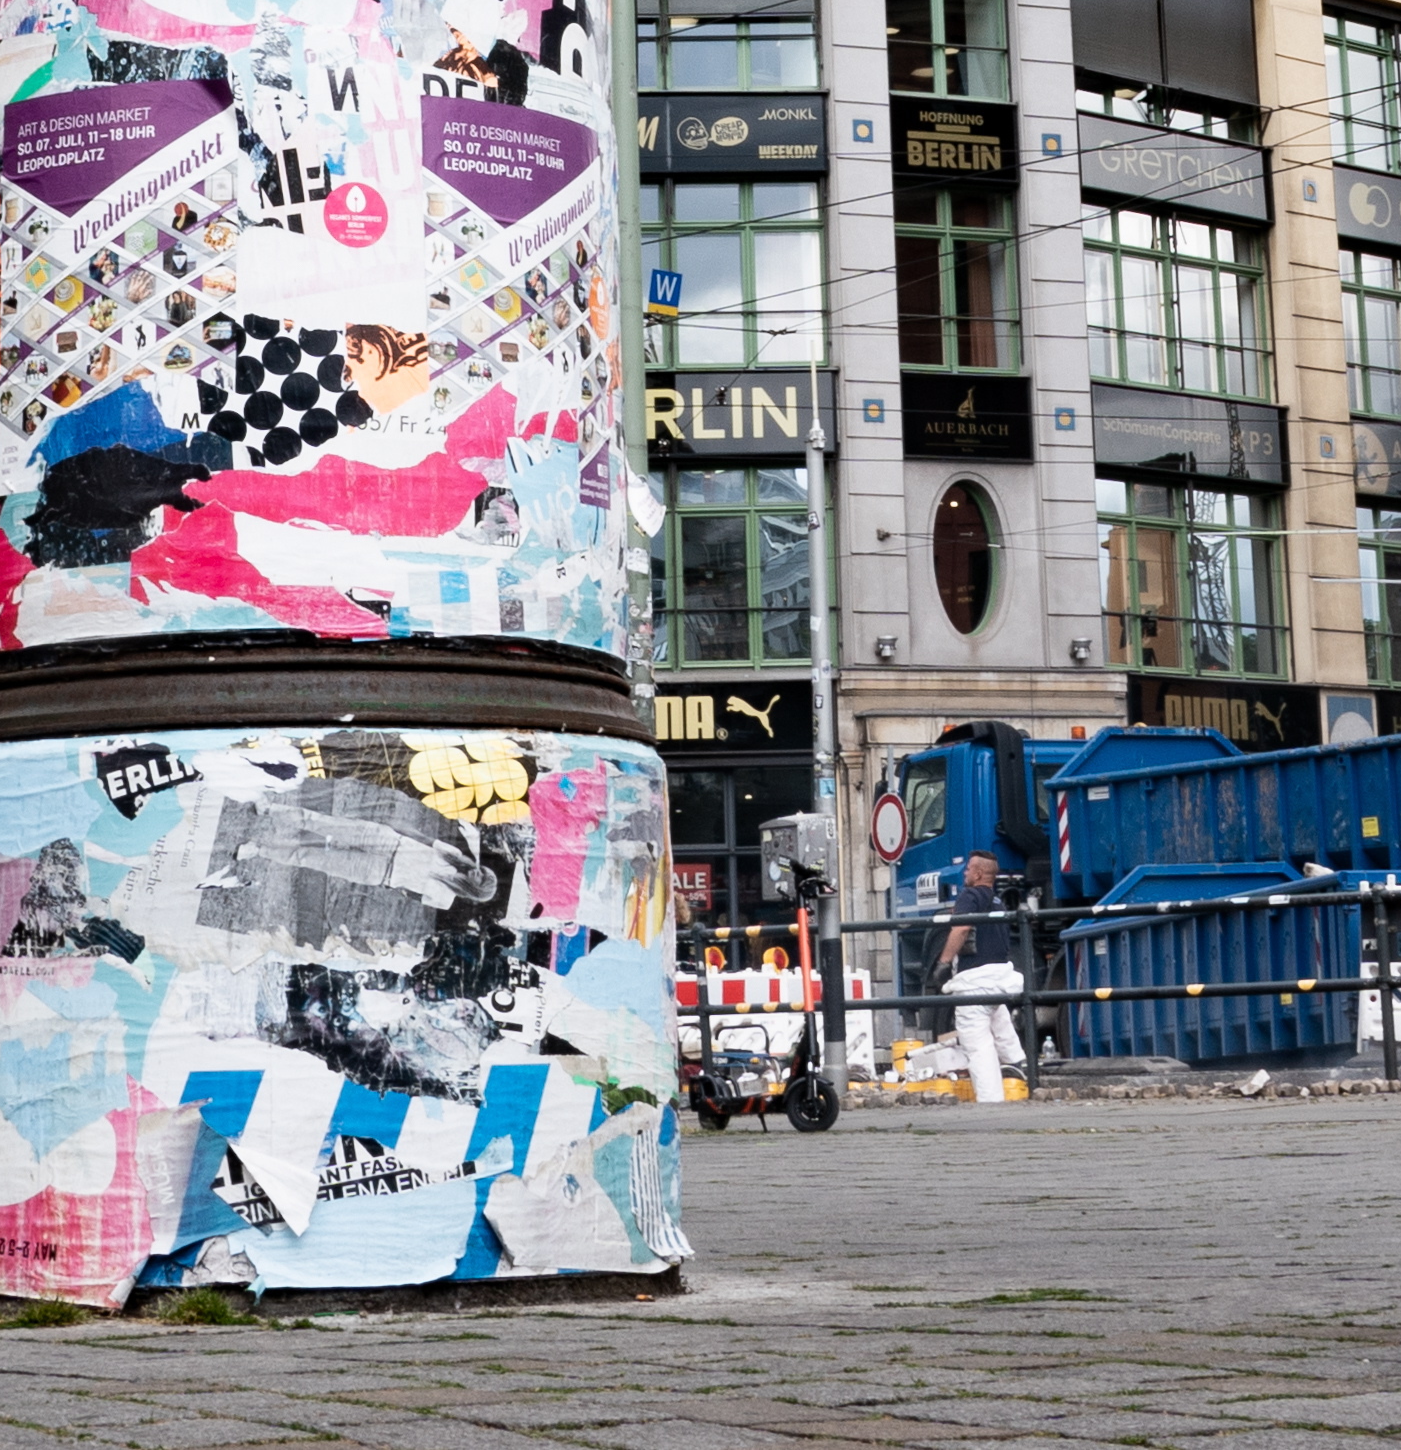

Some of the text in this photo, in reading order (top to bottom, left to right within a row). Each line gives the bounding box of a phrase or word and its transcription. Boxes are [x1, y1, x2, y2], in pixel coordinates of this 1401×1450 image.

[17, 107, 152, 138] ART & DESIGN MARKET
[919, 110, 985, 127] HOFFNUNG
[17, 141, 35, 156] SO.
[36, 137, 53, 152] 07.
[55, 132, 85, 151] JULI,
[126, 125, 156, 140] UHR
[443, 121, 562, 153] ART & DESIGN MARKET
[758, 144, 819, 159] WEEKDAY
[17, 147, 106, 174] LEOPOLDPLATZ
[443, 139, 464, 154] SO.
[466, 142, 485, 157] 07.
[486, 145, 515, 163] JULI,
[545, 154, 566, 172] UHR
[443, 156, 534, 181] LEOPOLDPLATZ
[906, 139, 1001, 171] BERLIN
[72, 131, 226, 255] Weddingmarkt
[508, 180, 597, 267] Weddingmarkt
[656, 273, 678, 302] W
[924, 421, 1010, 437] AUERBACH
